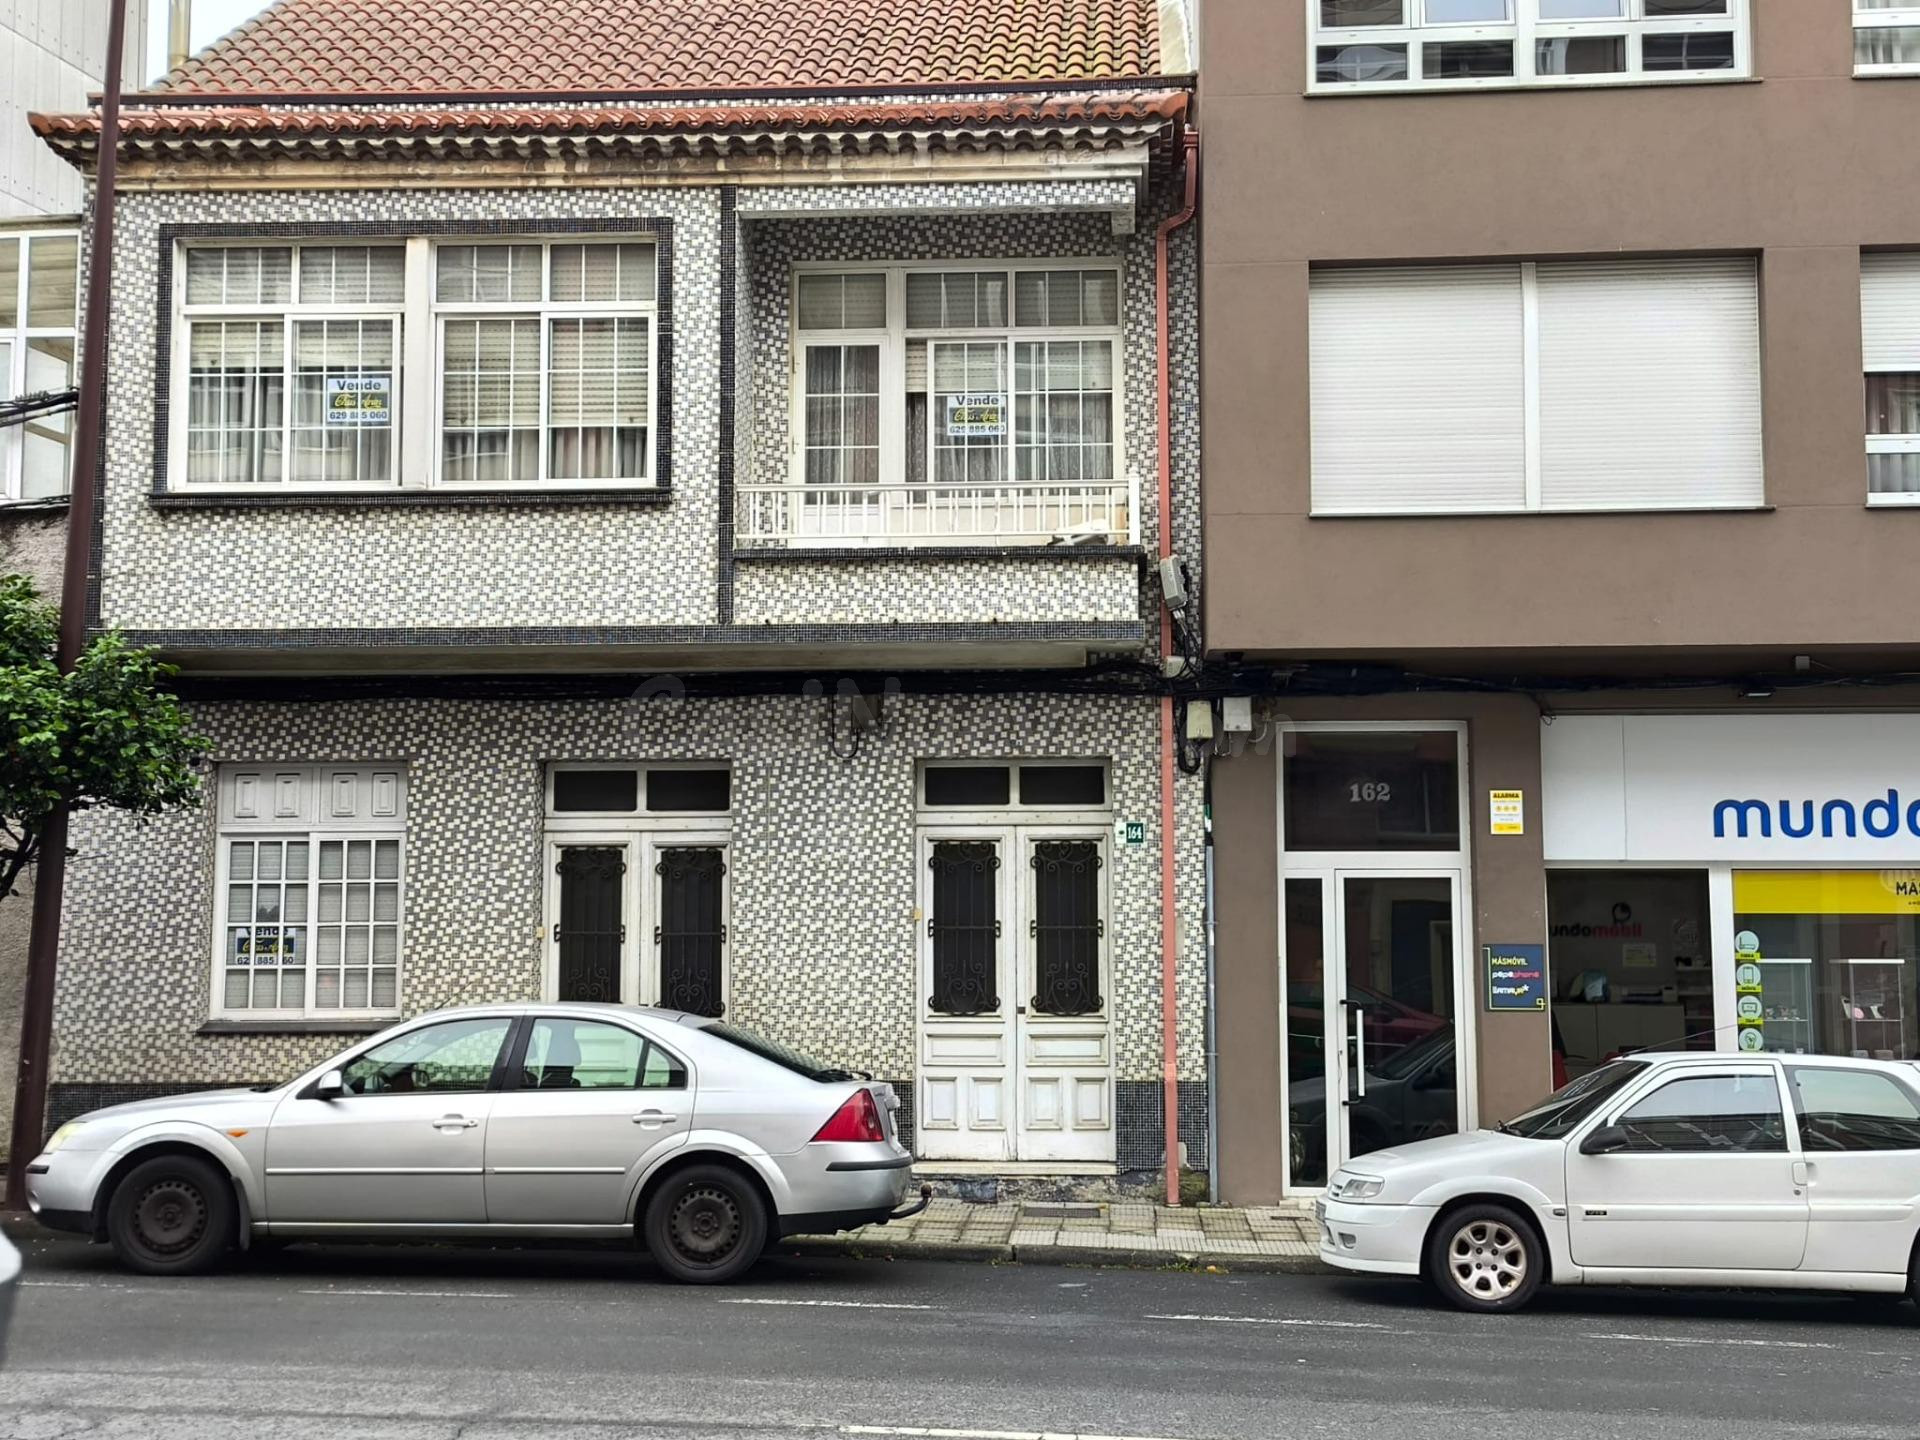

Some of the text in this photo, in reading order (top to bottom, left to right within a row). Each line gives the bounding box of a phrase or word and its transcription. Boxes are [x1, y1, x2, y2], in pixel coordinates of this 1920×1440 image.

[337, 380, 382, 391] Vende
[956, 395, 999, 406] Vende
[329, 411, 347, 420] 629
[1350, 782, 1391, 803] 162
[1127, 826, 1142, 839] 164
[1896, 878, 1920, 896] MÁ
